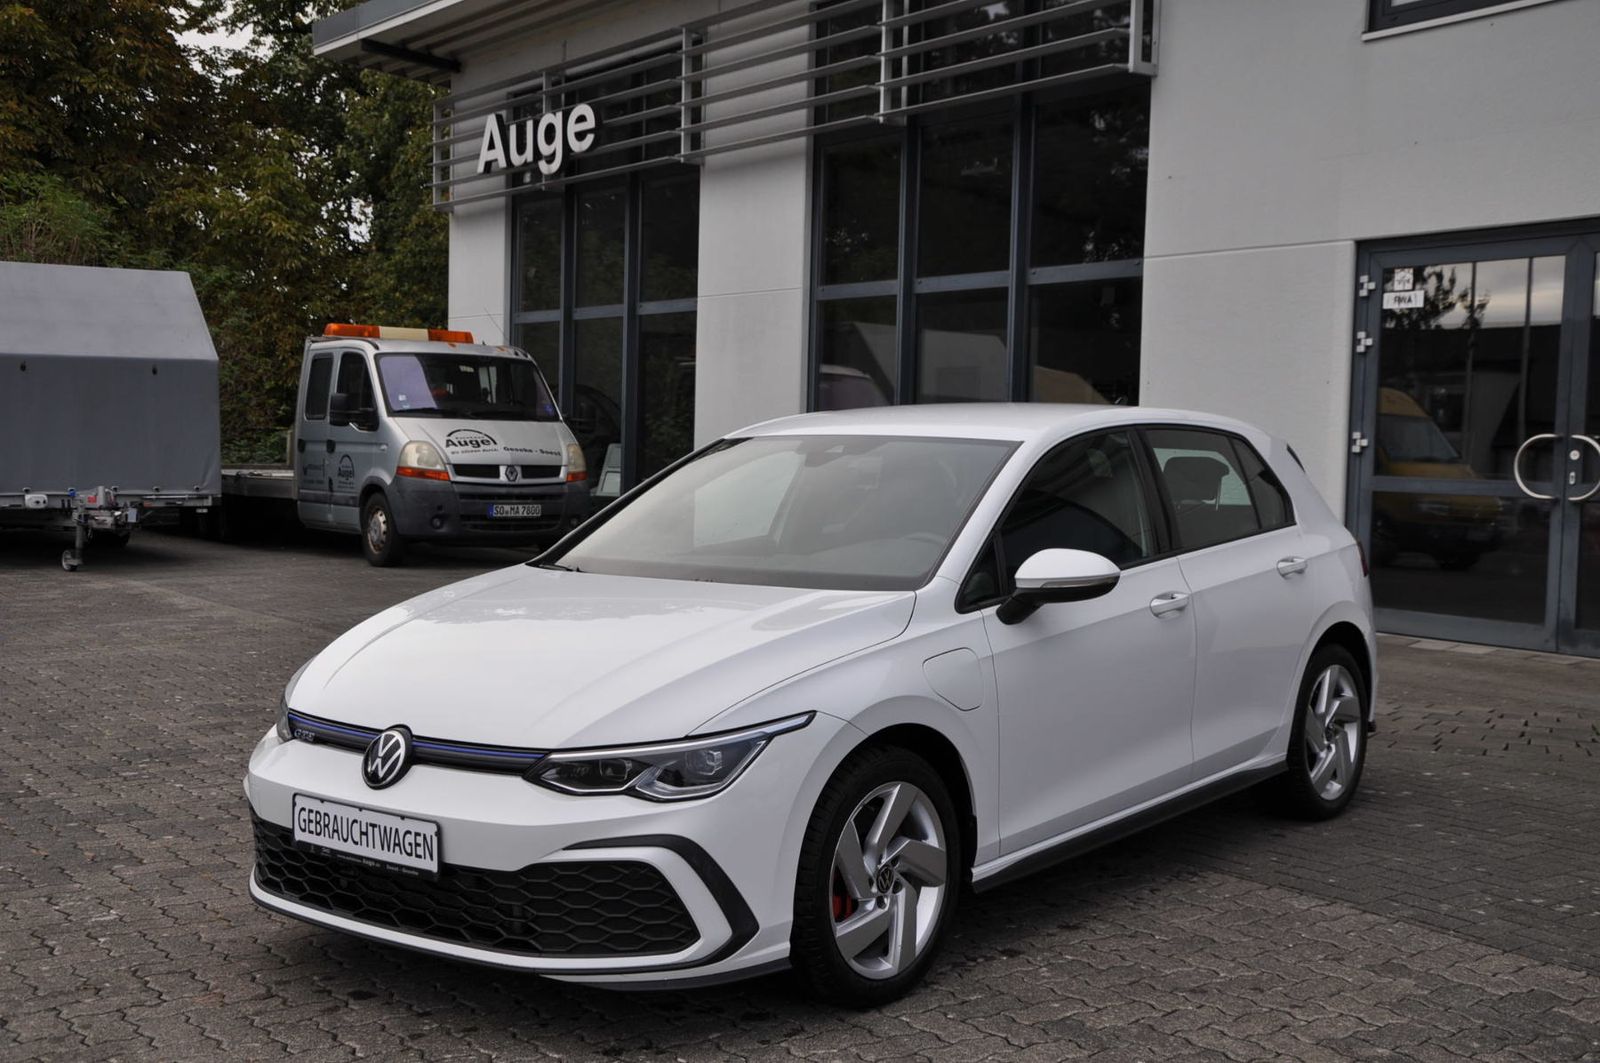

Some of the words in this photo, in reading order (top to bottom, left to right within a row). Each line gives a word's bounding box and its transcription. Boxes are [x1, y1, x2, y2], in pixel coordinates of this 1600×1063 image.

[477, 103, 596, 175] Auge
[446, 439, 491, 448] Auge
[298, 807, 433, 861] GEBRAUCHTWAGEN
